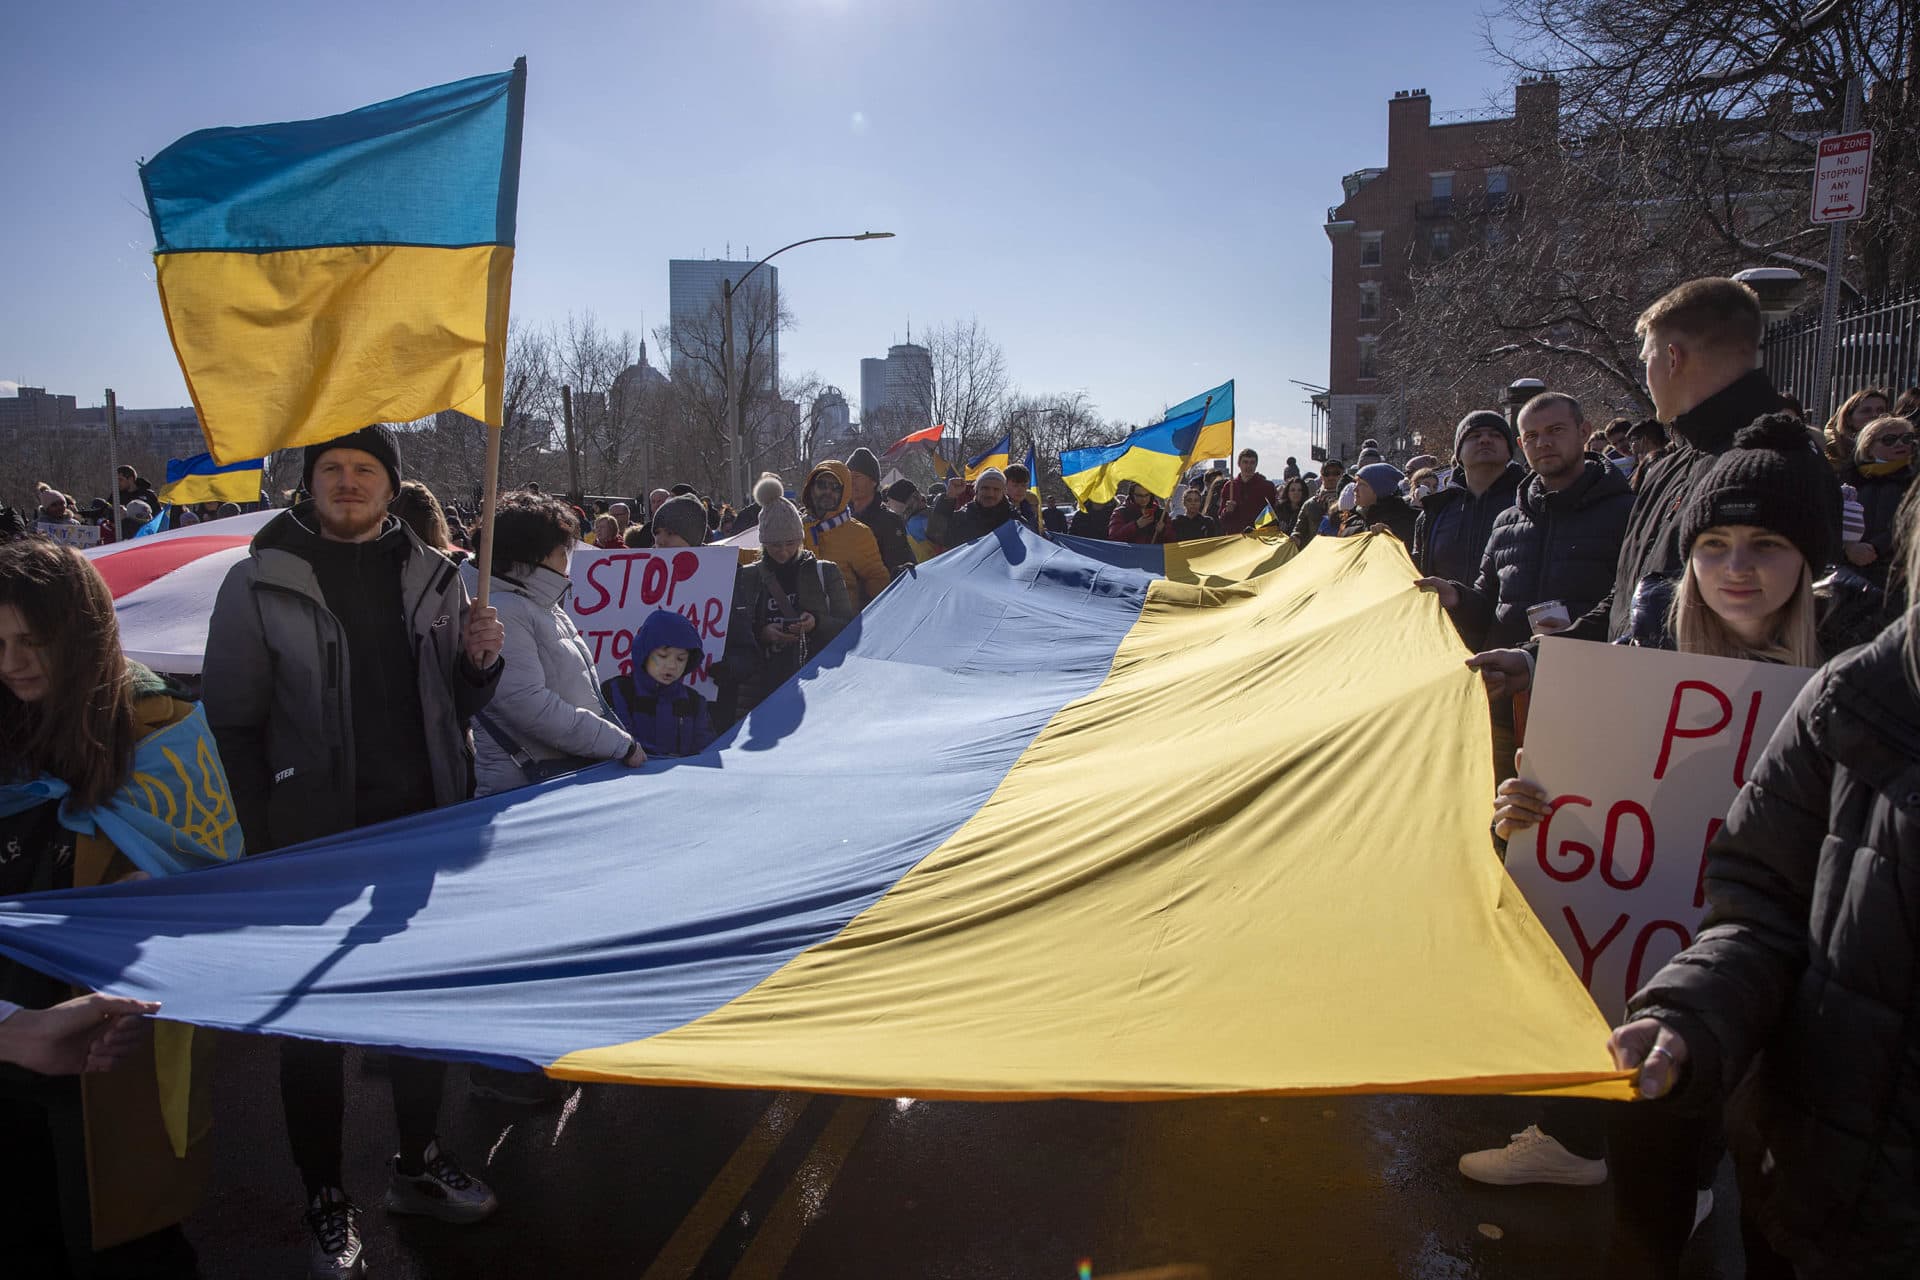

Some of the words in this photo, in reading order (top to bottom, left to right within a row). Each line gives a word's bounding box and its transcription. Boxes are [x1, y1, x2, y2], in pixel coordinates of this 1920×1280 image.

[1823, 143, 1840, 153] TOW
[1844, 137, 1868, 150] ZONE
[1836, 156, 1850, 166] NO
[1820, 166, 1865, 180] STOPPING
[1831, 181, 1850, 191] ANY
[1830, 193, 1849, 203] TIME
[573, 551, 699, 616] STOP
[658, 597, 725, 640] AR
[1536, 794, 1655, 891] GO
